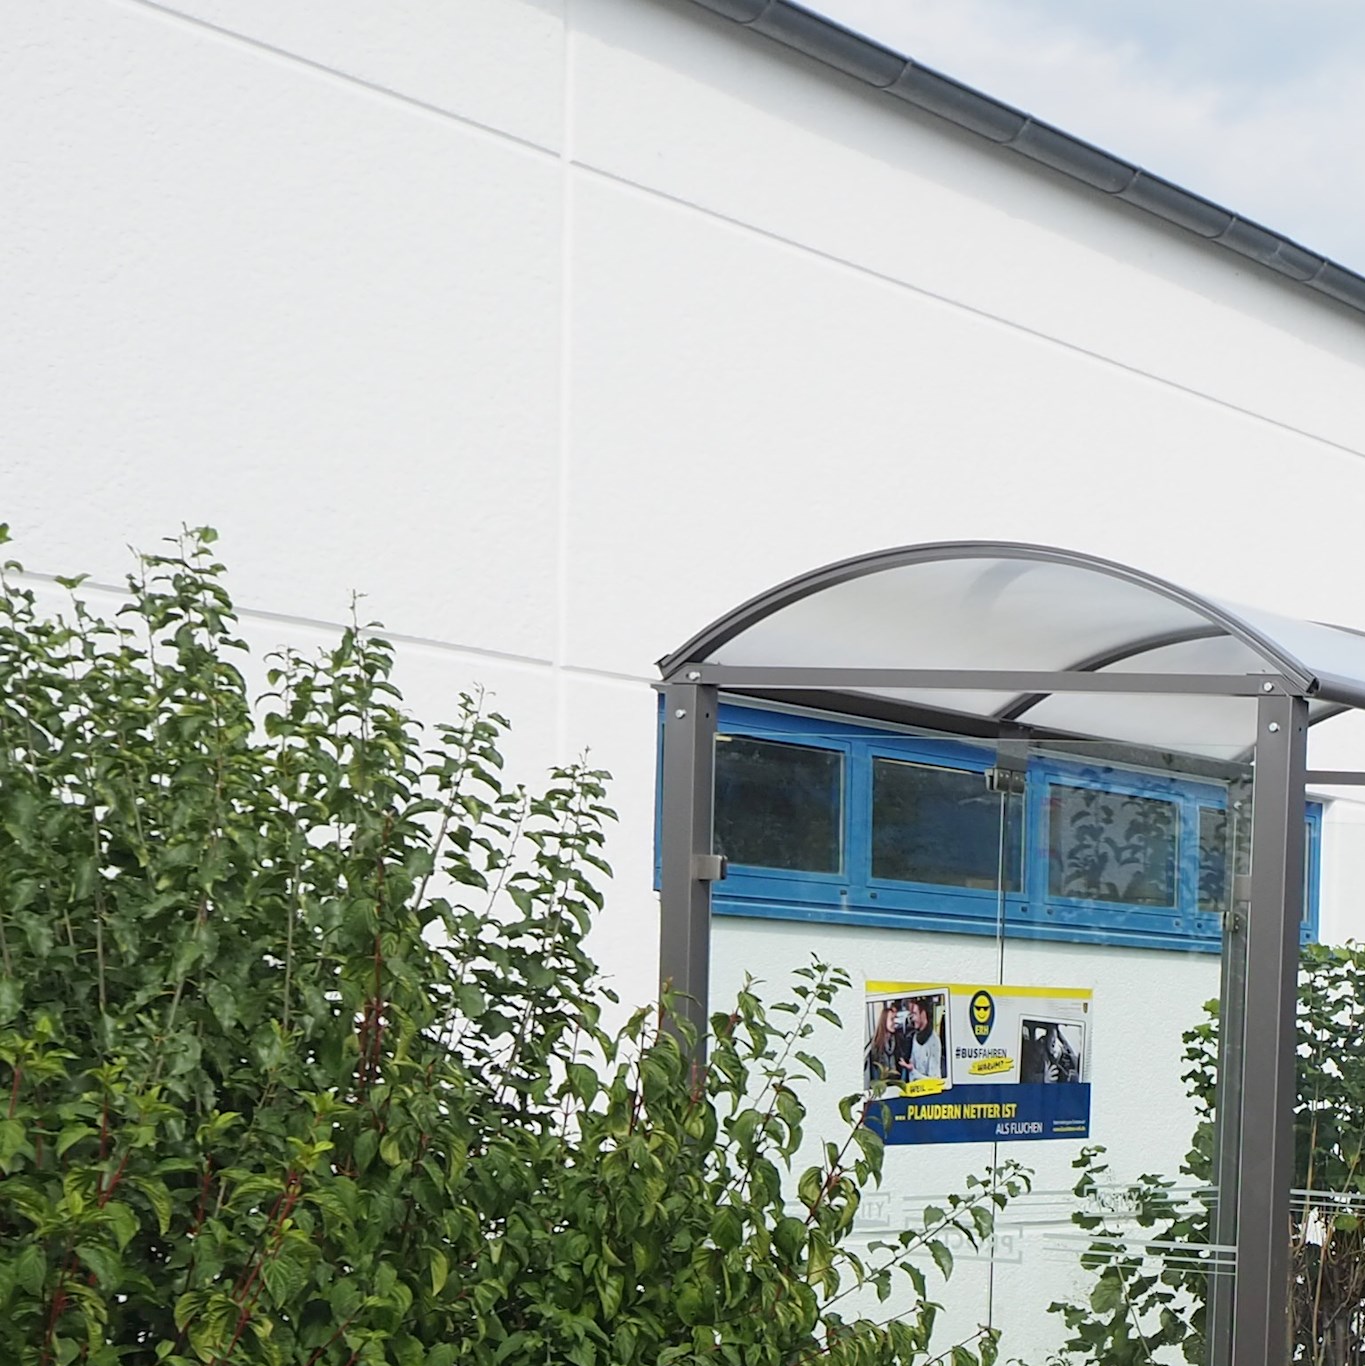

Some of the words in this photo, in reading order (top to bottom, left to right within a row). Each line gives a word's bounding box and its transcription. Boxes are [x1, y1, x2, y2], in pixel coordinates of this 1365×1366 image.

[975, 1025, 990, 1036] ERH
[955, 1047, 1007, 1060] #BUSFAHREN
[907, 1104, 961, 1120] PLAUDERN
[962, 1103, 1001, 1119] NETTER
[1002, 1103, 1017, 1118] IST
[995, 1123, 1010, 1135] ALS
[1010, 1121, 1043, 1134] FLUCHEN
